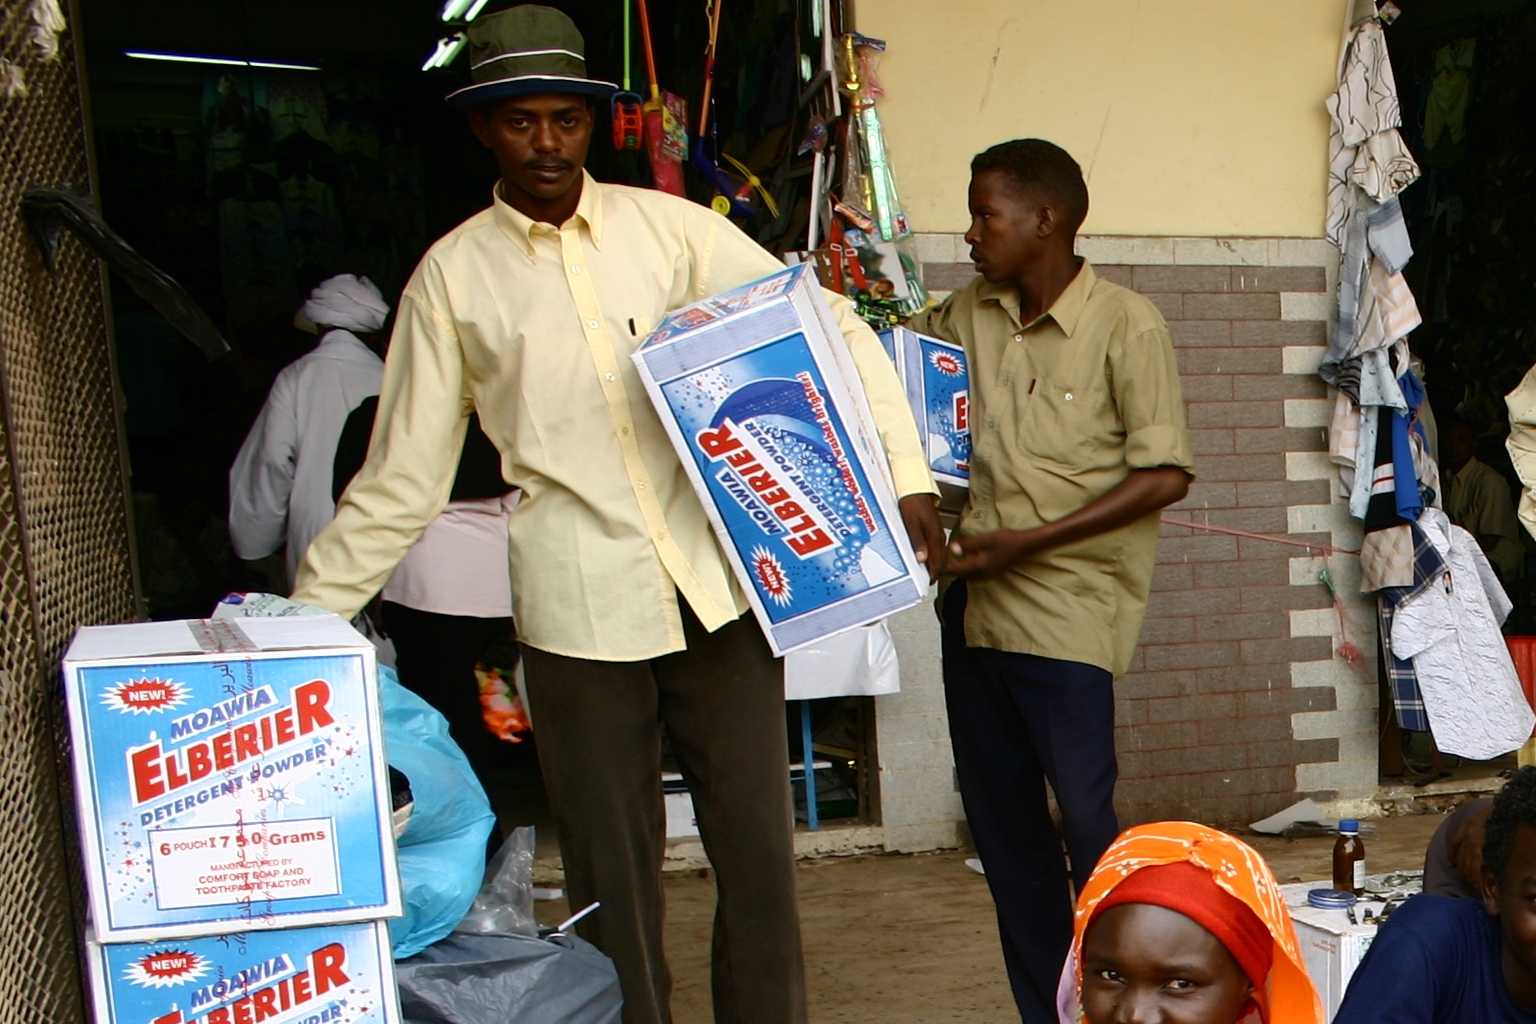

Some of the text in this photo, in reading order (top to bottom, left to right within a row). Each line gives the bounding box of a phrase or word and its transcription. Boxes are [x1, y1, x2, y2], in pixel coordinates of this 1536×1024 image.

[698, 423, 835, 556] ELBERIER
[720, 471, 781, 535] MOAWIA
[745, 422, 850, 538] DETERGENT POWDER
[128, 689, 167, 702] NEW!
[171, 689, 271, 739] MOAWIA
[131, 681, 336, 804] ELBERIER
[141, 744, 328, 826] DETERGENT POWDER
[160, 843, 171, 856] 6
[174, 839, 207, 851] POUCH
[270, 831, 326, 846] Grams
[281, 858, 293, 866] BY
[198, 868, 304, 884] COMFORT SOAP AND
[265, 877, 312, 889] FACTORY
[151, 958, 188, 971] NEW!
[191, 955, 289, 1008] MOAWIA
